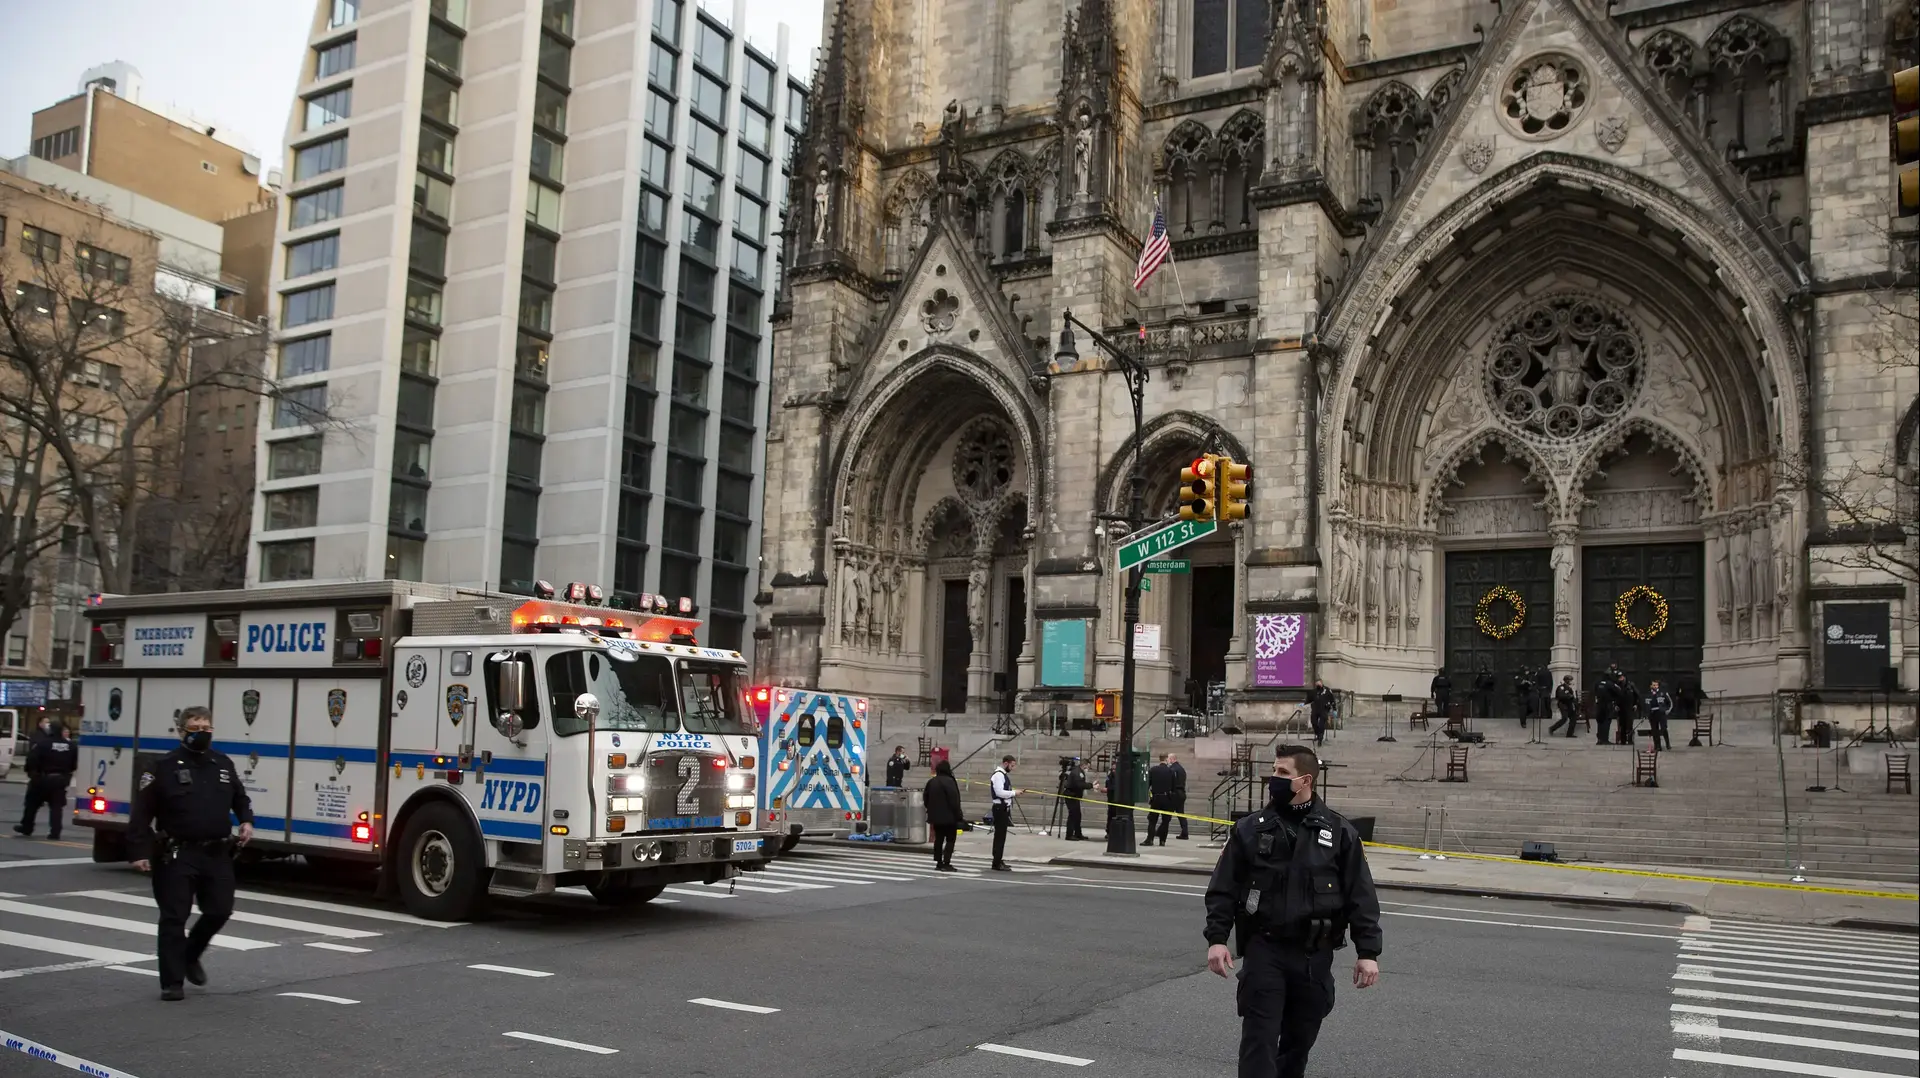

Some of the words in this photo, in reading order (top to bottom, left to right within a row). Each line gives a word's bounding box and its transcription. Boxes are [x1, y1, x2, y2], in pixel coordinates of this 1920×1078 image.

[1138, 541, 1149, 557] W
[1155, 530, 1175, 550] 112
[1180, 521, 1194, 539] St
[134, 626, 194, 641] EMERGENCY
[246, 622, 326, 653] POLICE
[142, 643, 184, 656] SERVICE
[704, 649, 724, 658] TWO
[662, 733, 704, 741] NYPD
[656, 740, 712, 749] POLICE
[97, 759, 107, 786] 2
[677, 755, 701, 815] 2
[799, 783, 839, 793] AMBULANCE
[481, 779, 541, 813] NYPD
[735, 841, 752, 851] 5702
